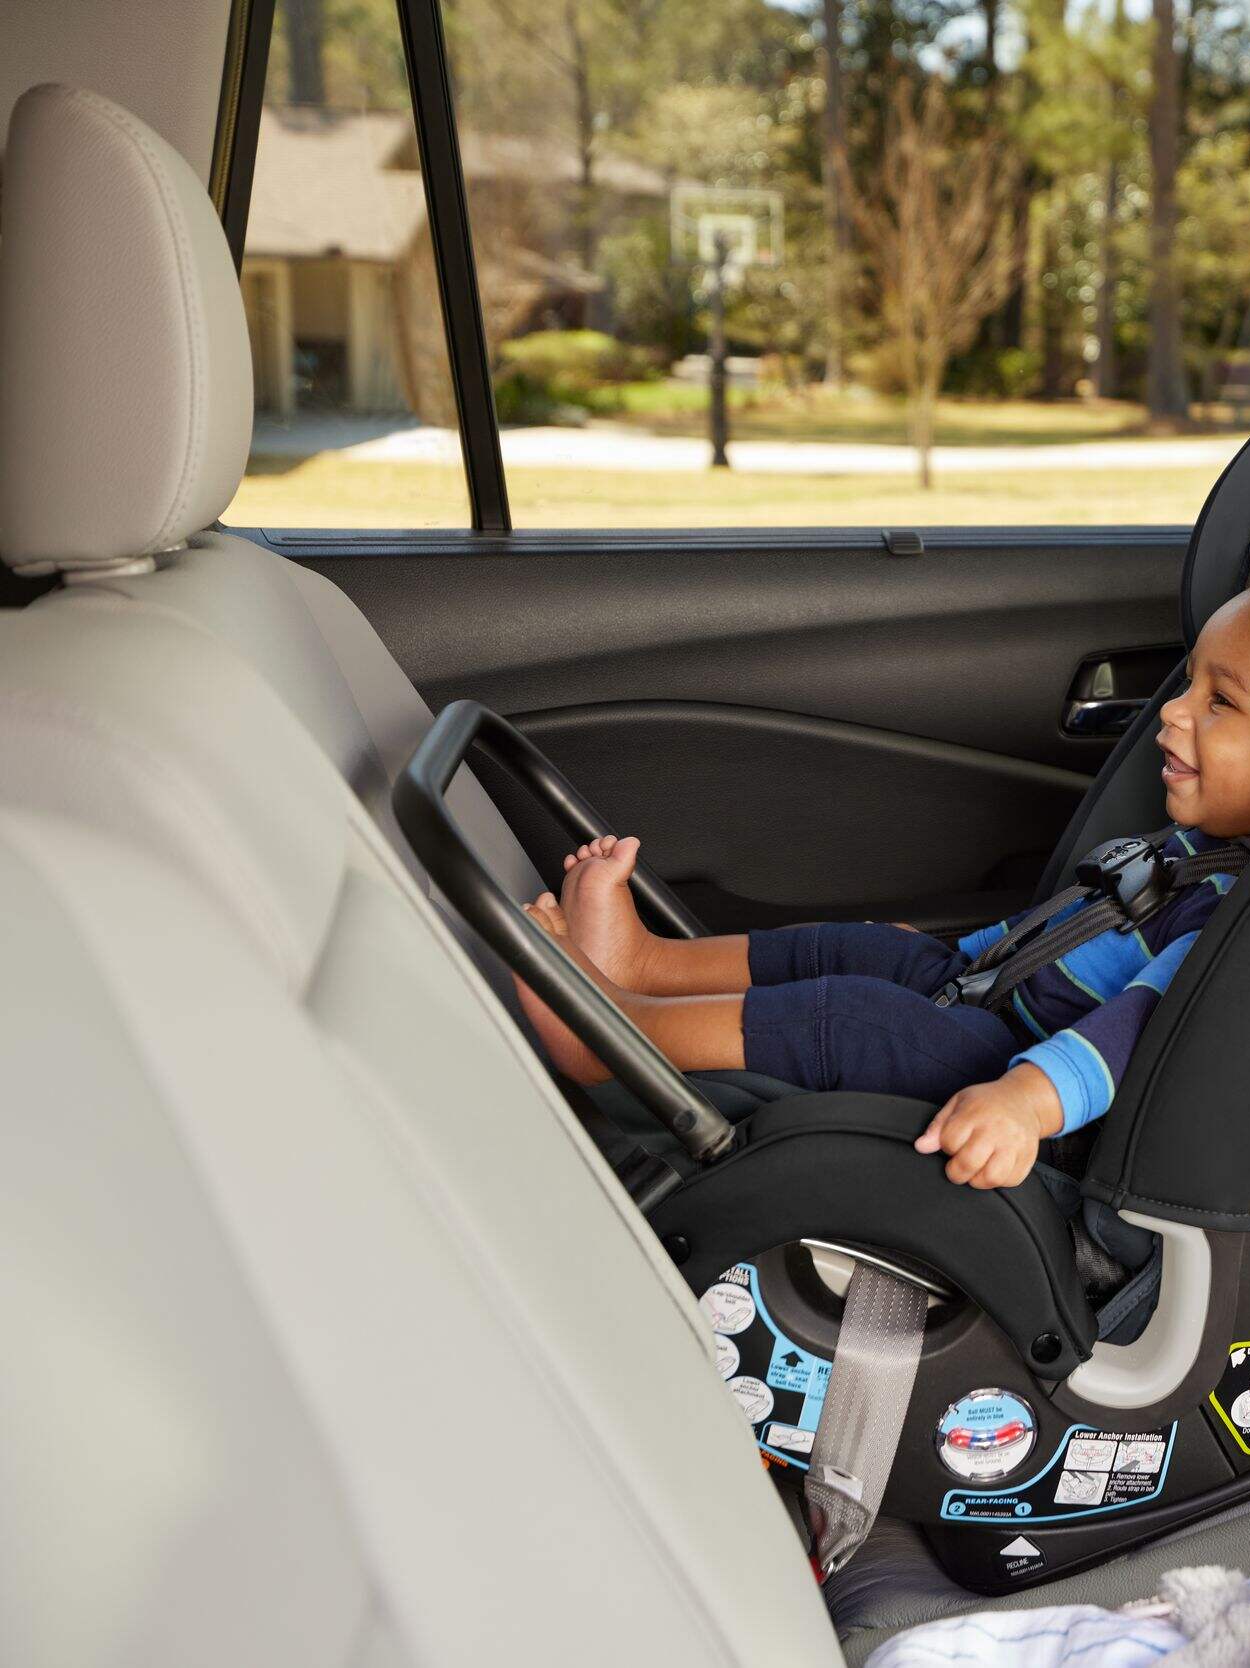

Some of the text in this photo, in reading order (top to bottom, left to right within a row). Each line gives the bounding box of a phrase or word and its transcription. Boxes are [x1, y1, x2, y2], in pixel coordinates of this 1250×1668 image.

[719, 1273, 749, 1286] PTIONS
[771, 1363, 811, 1375] Lower anchor
[1075, 1431, 1162, 1441] Lower Anchor Installation
[1006, 1558, 1028, 1570] RECLINE
